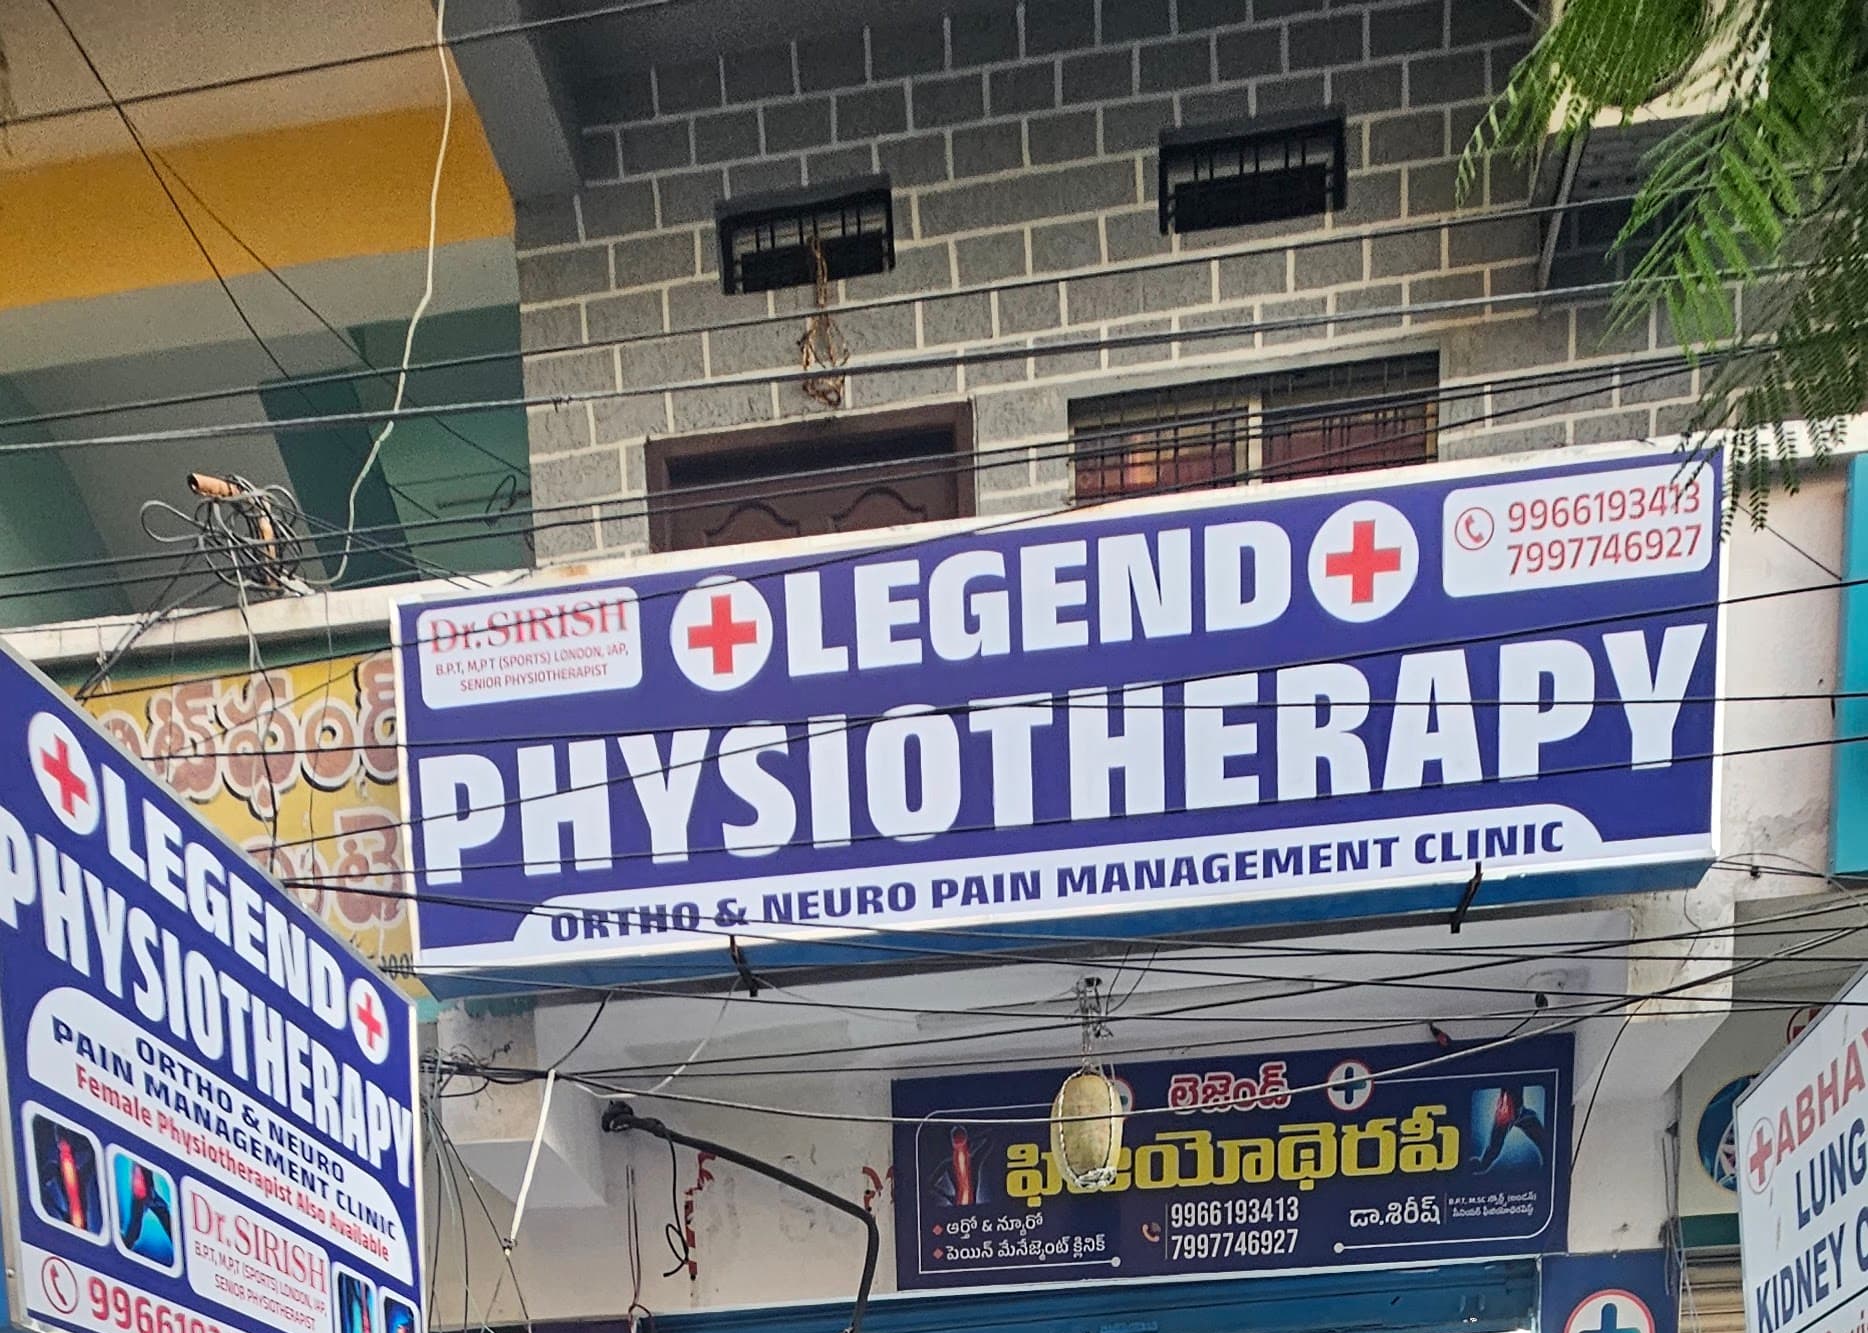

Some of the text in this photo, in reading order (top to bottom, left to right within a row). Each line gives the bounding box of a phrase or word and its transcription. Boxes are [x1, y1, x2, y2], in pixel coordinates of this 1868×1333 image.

[1507, 523, 1702, 577] 7997746927
[1508, 480, 1701, 534] 9966193413
[429, 599, 629, 655] Dr.SIRISH
[784, 520, 1292, 679] LEGEND
[460, 673, 502, 692] SENIOR
[504, 663, 608, 688] PHYSIOTHERAPIST
[418, 622, 1709, 886] PHYSIOTHERAPY
[101, 762, 347, 1031] LEGEND
[550, 819, 1566, 945] ORTHO & NEURO PAIN MANAGEMENT CLINIC
[0, 804, 413, 1188] PHYSIOTHERAPY
[52, 1014, 398, 1241] PAIN MANAGEMENT CLINIC
[75, 1062, 390, 1262] Female Physiotherapist Also Available
[136, 1036, 345, 1184] ORTHO & NEURO
[981, 1219, 994, 1233] &
[1171, 1196, 1300, 1229] 9966193413
[1795, 1117, 1868, 1231] LUNG
[190, 1190, 327, 1296] Dr.SIRISH
[1171, 1228, 1300, 1261] 7997746927
